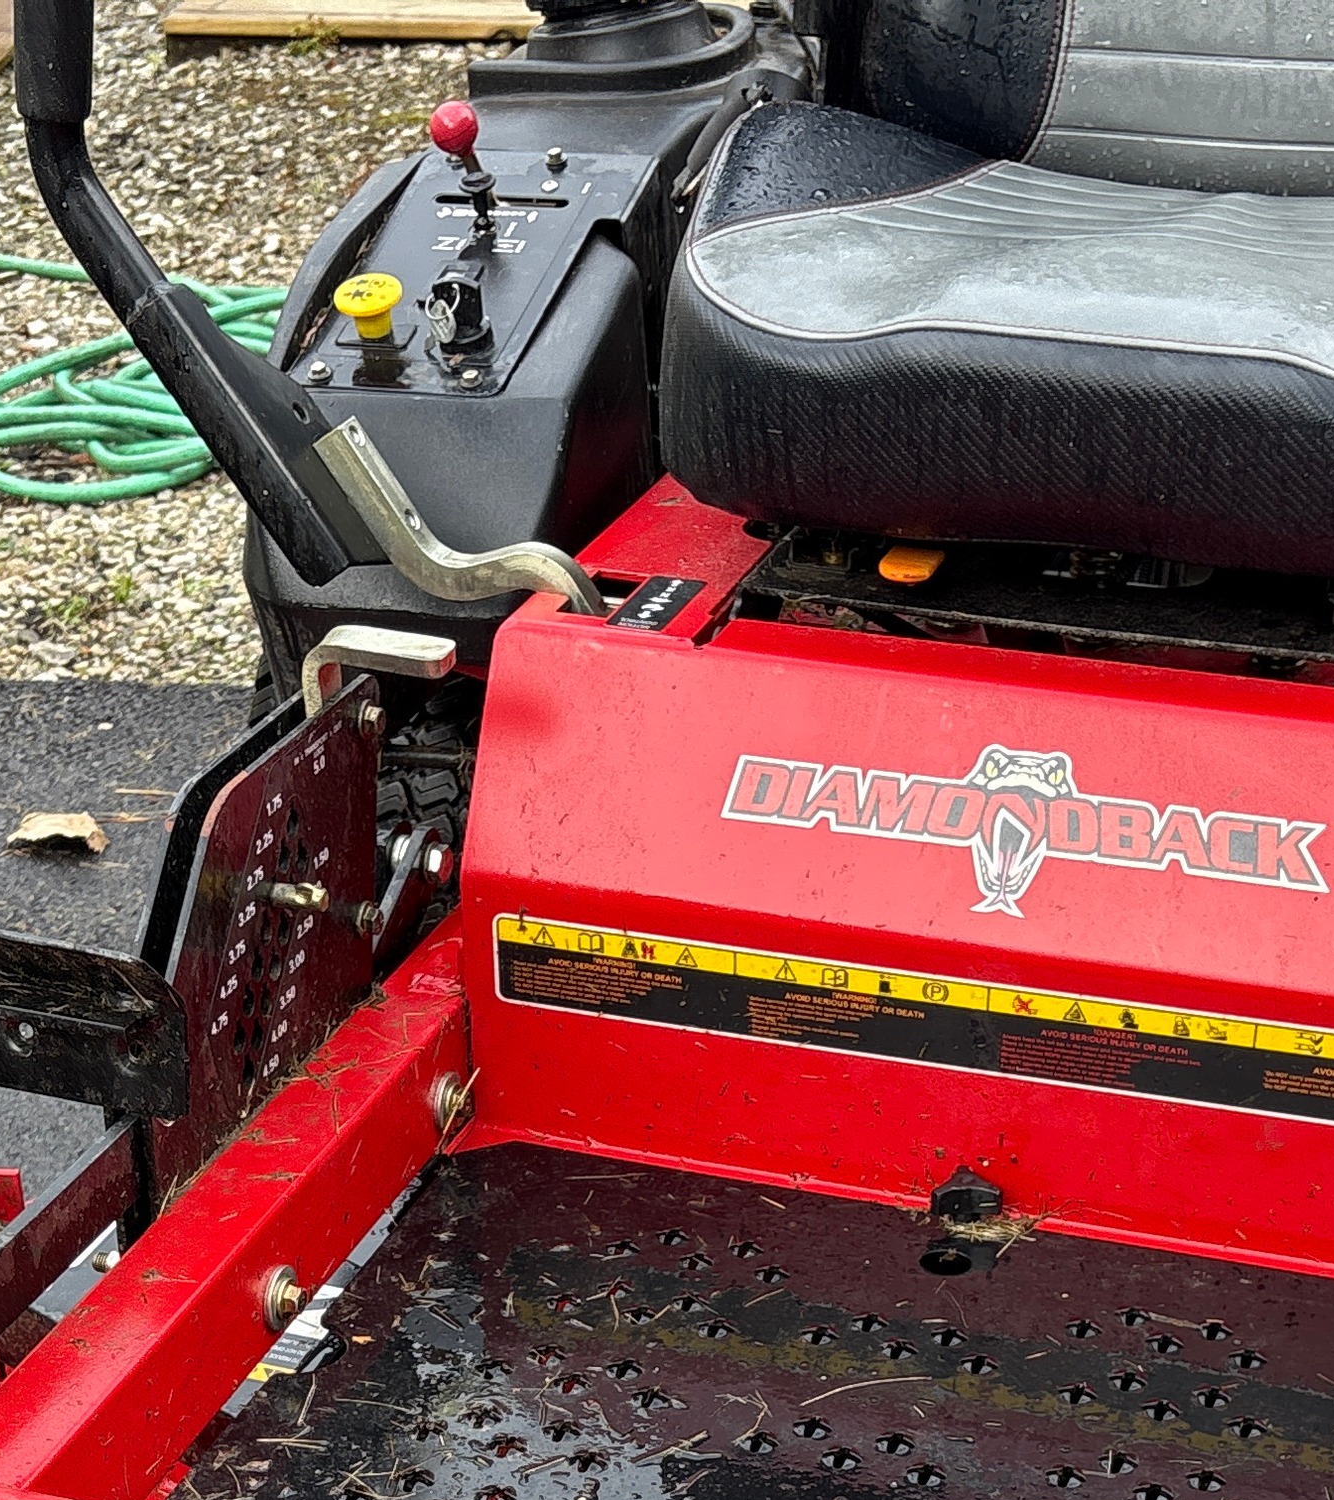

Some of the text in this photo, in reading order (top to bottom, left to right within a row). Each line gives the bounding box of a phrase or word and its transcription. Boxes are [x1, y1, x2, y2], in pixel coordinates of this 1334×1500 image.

[266, 793, 283, 817] 1.75
[256, 829, 274, 855] 2.25
[313, 846, 329, 870] 1.50
[247, 865, 264, 891] 2.75
[238, 901, 256, 927] 3.25
[297, 914, 314, 940] 2.50
[228, 939, 246, 965] 3.75
[288, 949, 305, 974] 3.00
[220, 974, 238, 999] 4.25
[279, 985, 296, 1010] 3.50
[211, 1011, 228, 1035] 4.75
[271, 1019, 287, 1043] 4.00
[1041, 1030, 1067, 1039] AVOID
[1070, 1034, 1109, 1044] SERIOUS
[1110, 1040, 1141, 1049] INJURY
[1158, 1046, 1188, 1055] DEATH
[263, 1054, 279, 1077] 4.50
